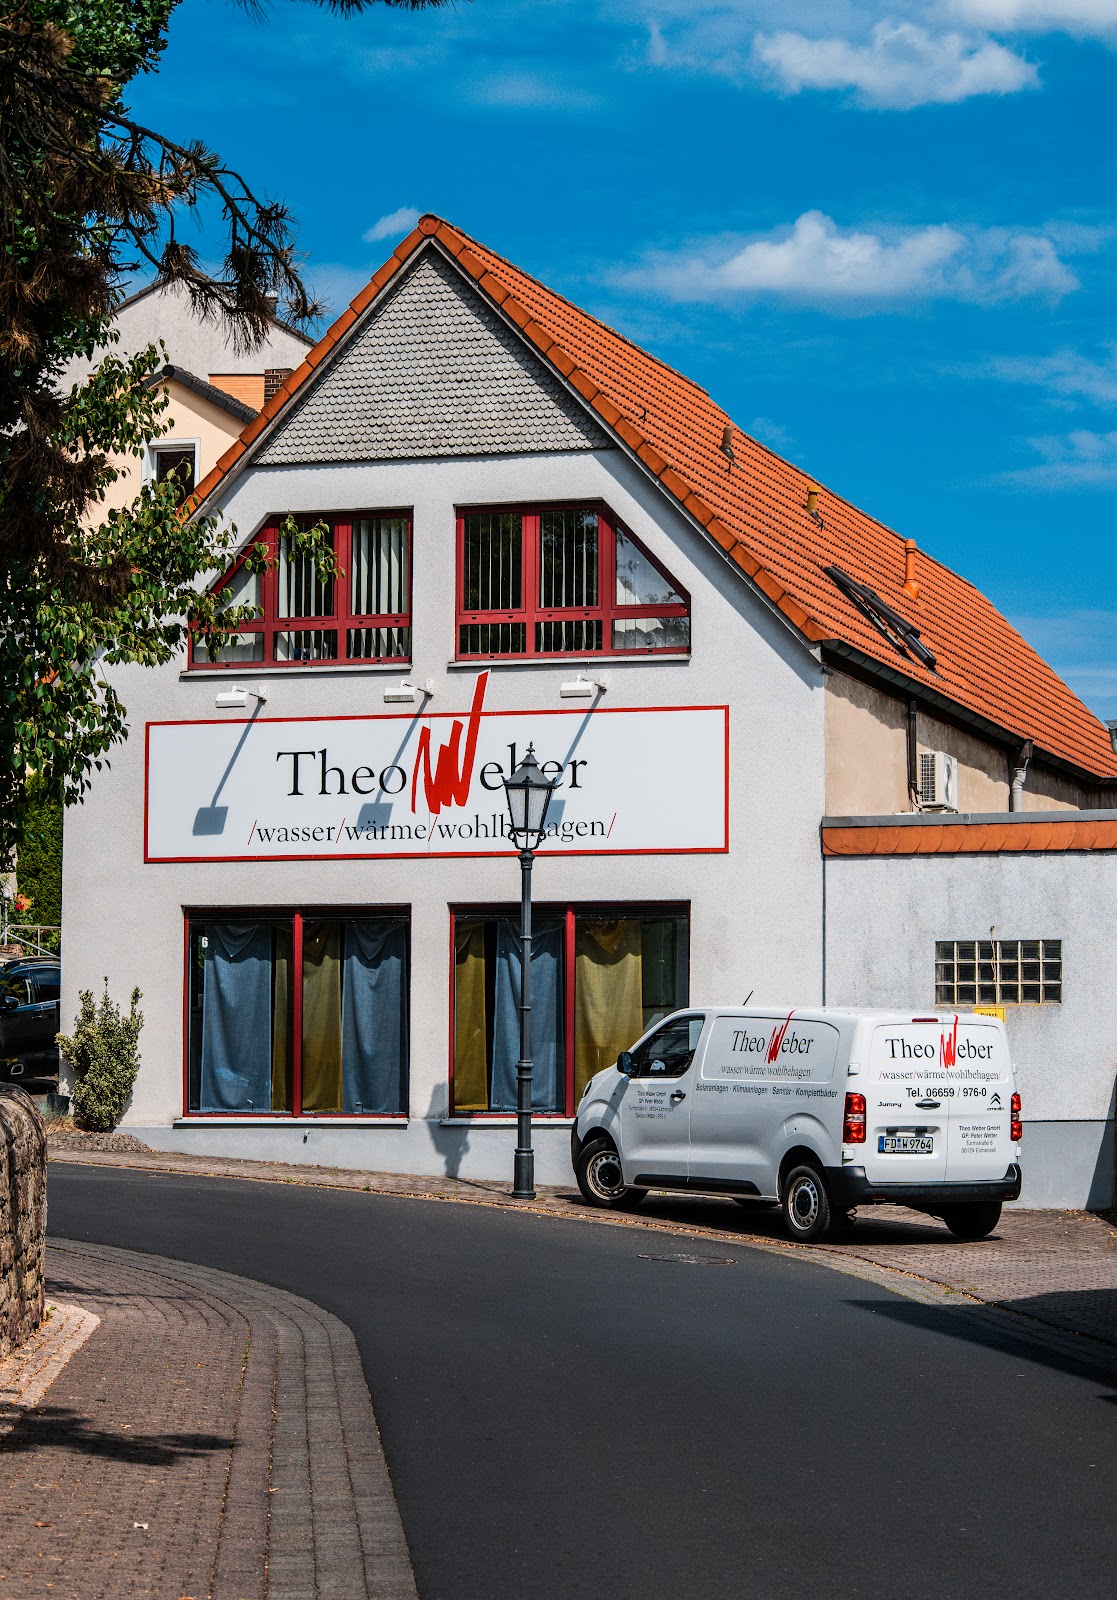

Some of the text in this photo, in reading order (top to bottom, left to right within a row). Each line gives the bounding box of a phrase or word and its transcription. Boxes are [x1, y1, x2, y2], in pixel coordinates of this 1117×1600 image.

[276, 748, 407, 796] Theo
[201, 936, 209, 948] 6
[731, 1009, 814, 1064] Theo Weber
[885, 1015, 993, 1069] Theo Weber
[695, 1083, 838, 1098] Solaranlagen Klimaanlagen Sanitär Komplettbäder
[906, 1088, 923, 1097] Tel.
[926, 1088, 955, 1098] 06659
[962, 1087, 987, 1097] 976-0
[910, 1138, 931, 1150] 9764
